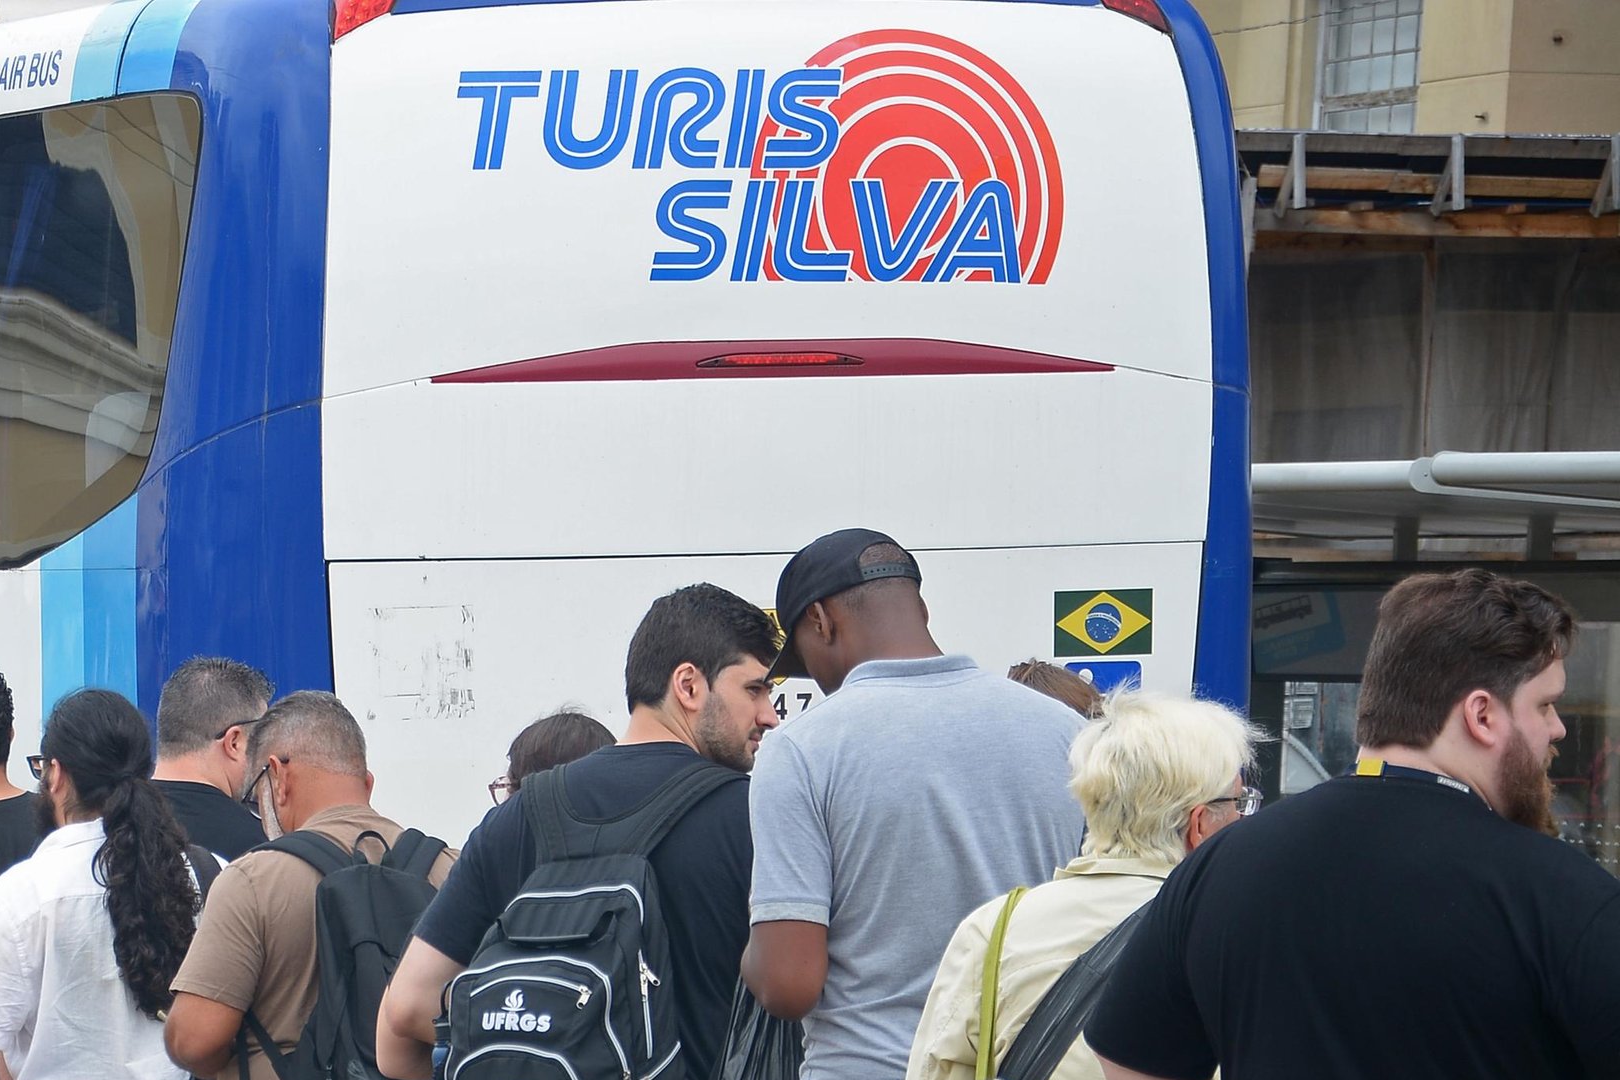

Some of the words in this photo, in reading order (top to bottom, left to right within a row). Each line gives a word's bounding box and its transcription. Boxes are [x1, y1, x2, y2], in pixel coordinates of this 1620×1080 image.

[27, 49, 63, 88] BUS
[457, 67, 842, 171] TURIS
[649, 179, 1022, 283] SILVA
[481, 1011, 552, 1033] UFRGS
